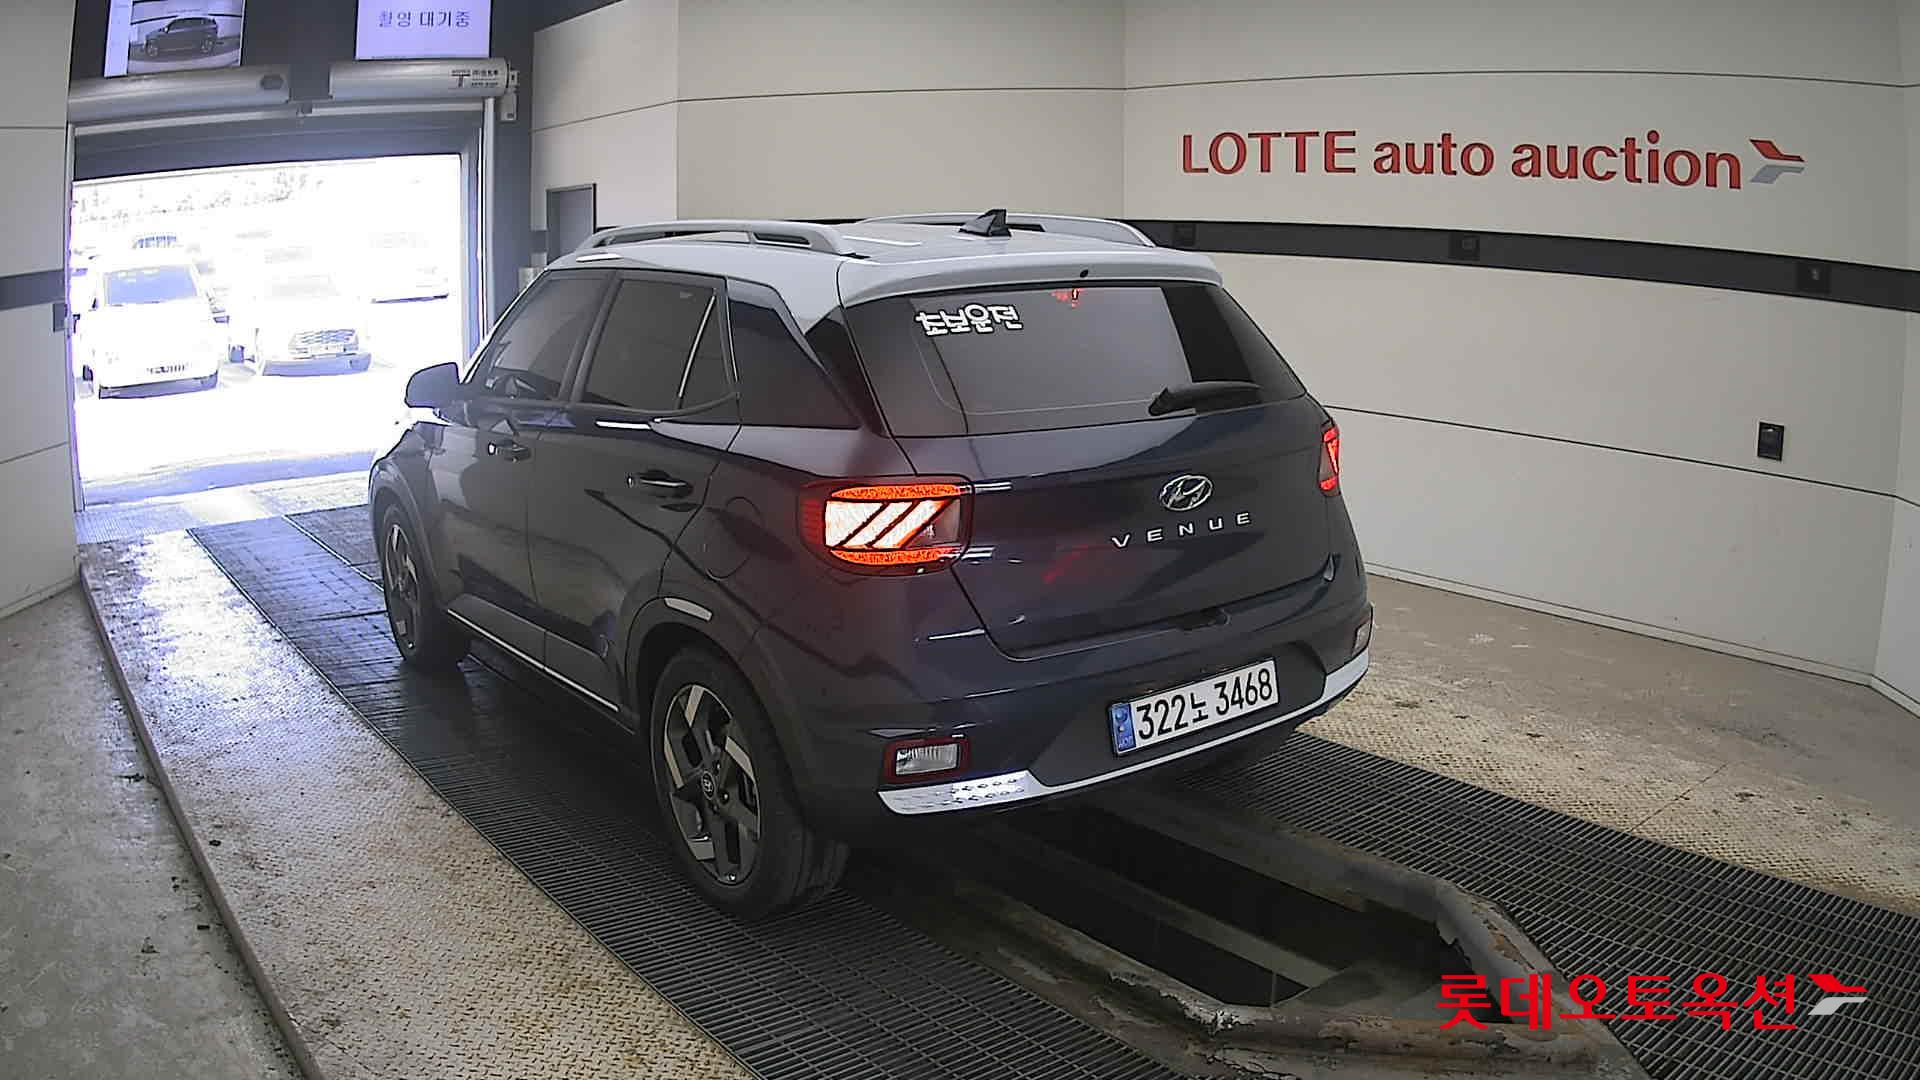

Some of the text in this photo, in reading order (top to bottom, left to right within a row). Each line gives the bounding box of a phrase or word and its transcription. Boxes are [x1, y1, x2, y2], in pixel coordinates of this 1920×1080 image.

[420, 11, 469, 27] 대기중
[1182, 129, 1742, 190] LOTTE auto auction
[914, 304, 1023, 336] 초보운전
[1111, 512, 1252, 548] VENUE
[1136, 667, 1273, 740] 322노 3468
